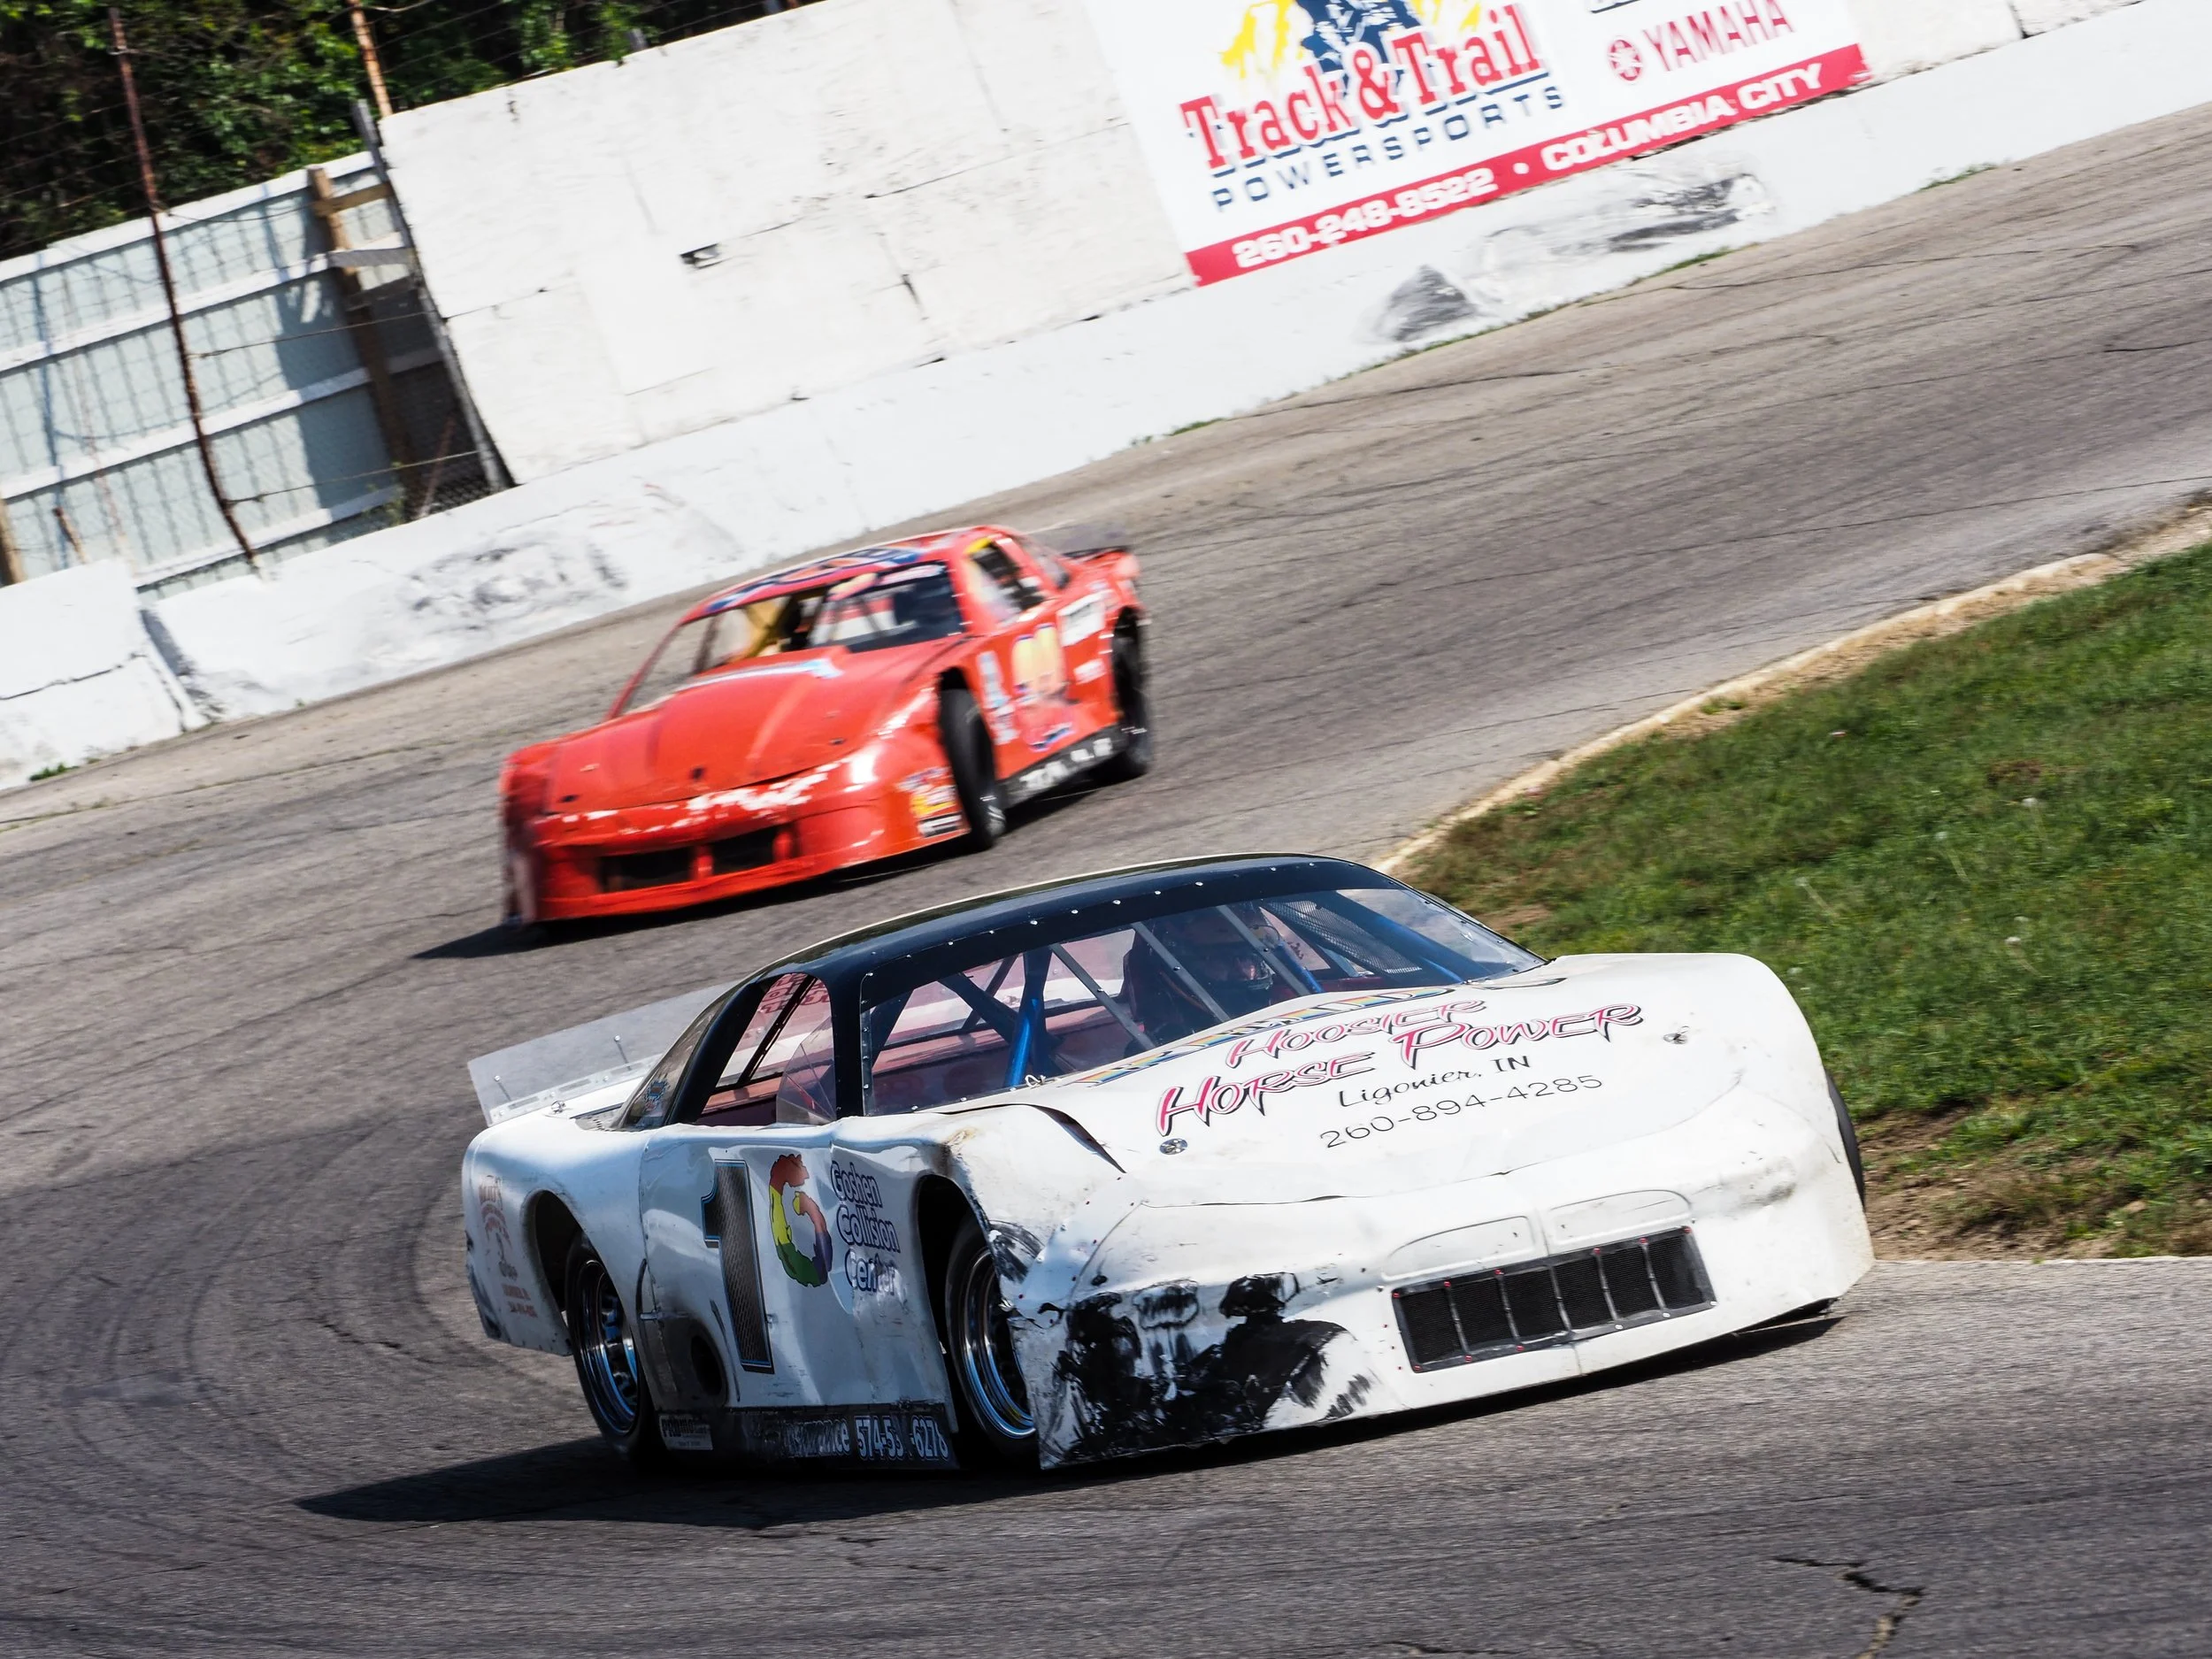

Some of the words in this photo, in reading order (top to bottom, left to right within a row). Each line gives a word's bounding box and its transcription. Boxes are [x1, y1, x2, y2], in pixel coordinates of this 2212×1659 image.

[1642, 0, 1796, 72] YAMAHA
[1211, 86, 1565, 211] POWERSPORTS
[1232, 167, 1498, 268] 260-248-8522
[1540, 95, 1737, 172] COLUMBIA
[1738, 63, 1823, 110] CITY
[1156, 1051, 1376, 1136] HORSE
[1388, 1003, 1644, 1070] POWER
[1225, 999, 1486, 1068] HOOSIER
[1491, 1055, 1532, 1073] IN
[1320, 1075, 1602, 1148] 260-894-4285
[831, 1160, 883, 1209] Goshen
[836, 1204, 901, 1254] Collision
